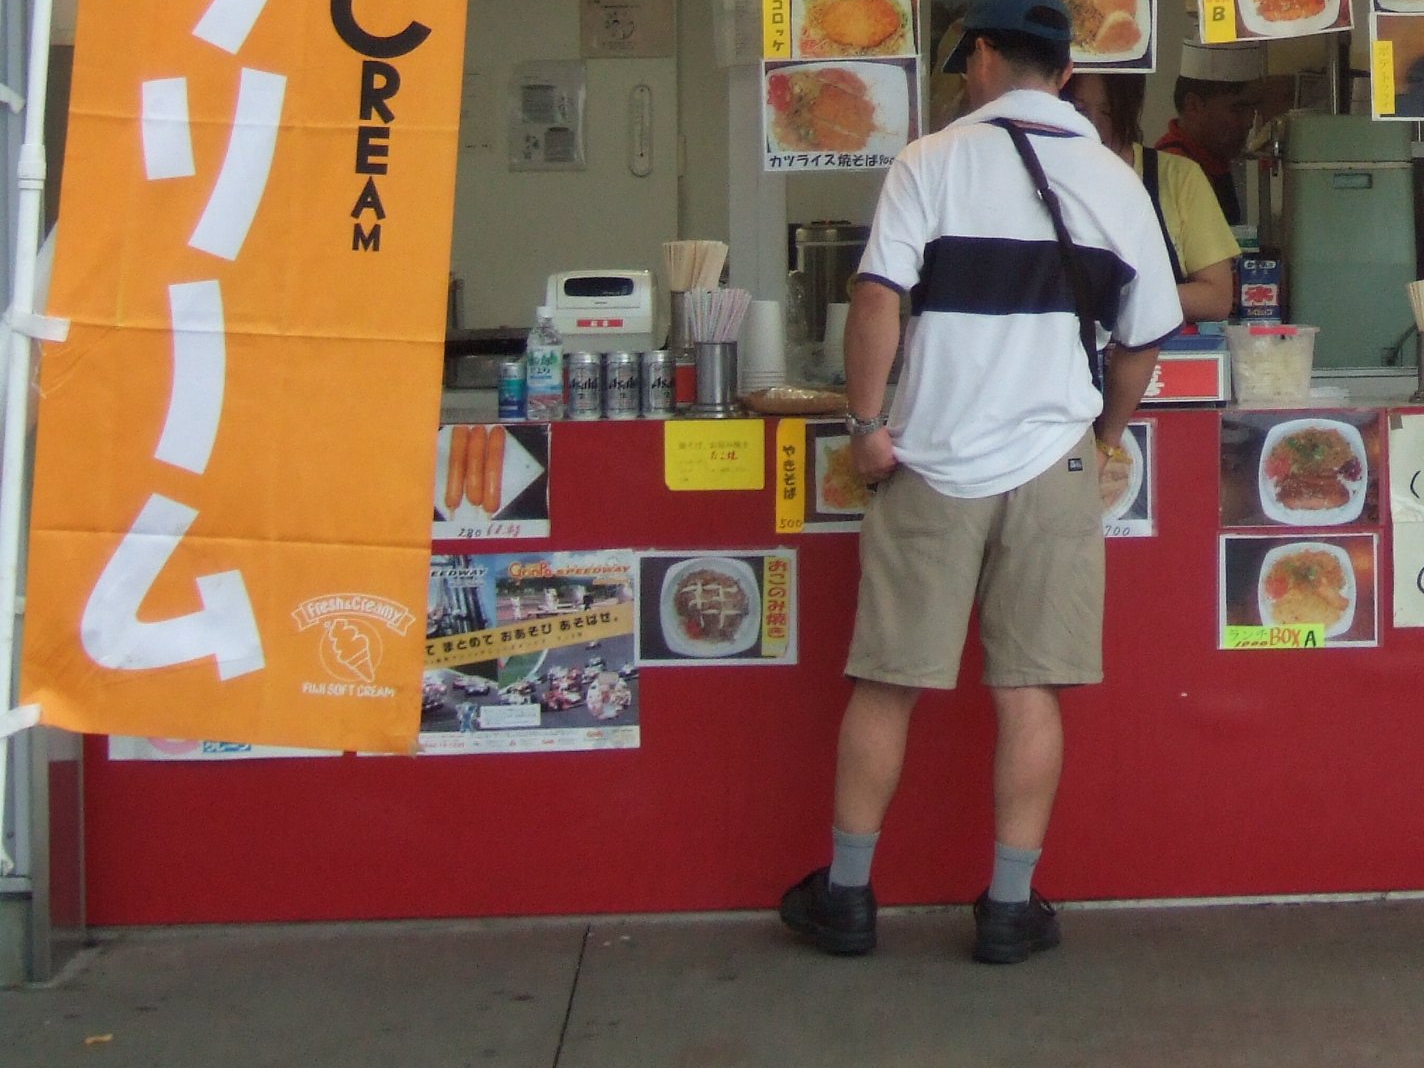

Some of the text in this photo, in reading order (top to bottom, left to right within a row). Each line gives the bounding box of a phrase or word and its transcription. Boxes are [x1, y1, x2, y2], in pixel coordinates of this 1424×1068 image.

[1212, 6, 1226, 22] B
[771, 0, 785, 52] コロッケ
[782, 444, 798, 500] やきそば
[779, 519, 804, 529] 500
[1269, 626, 1301, 647] BOX
[1304, 630, 1317, 648] A
